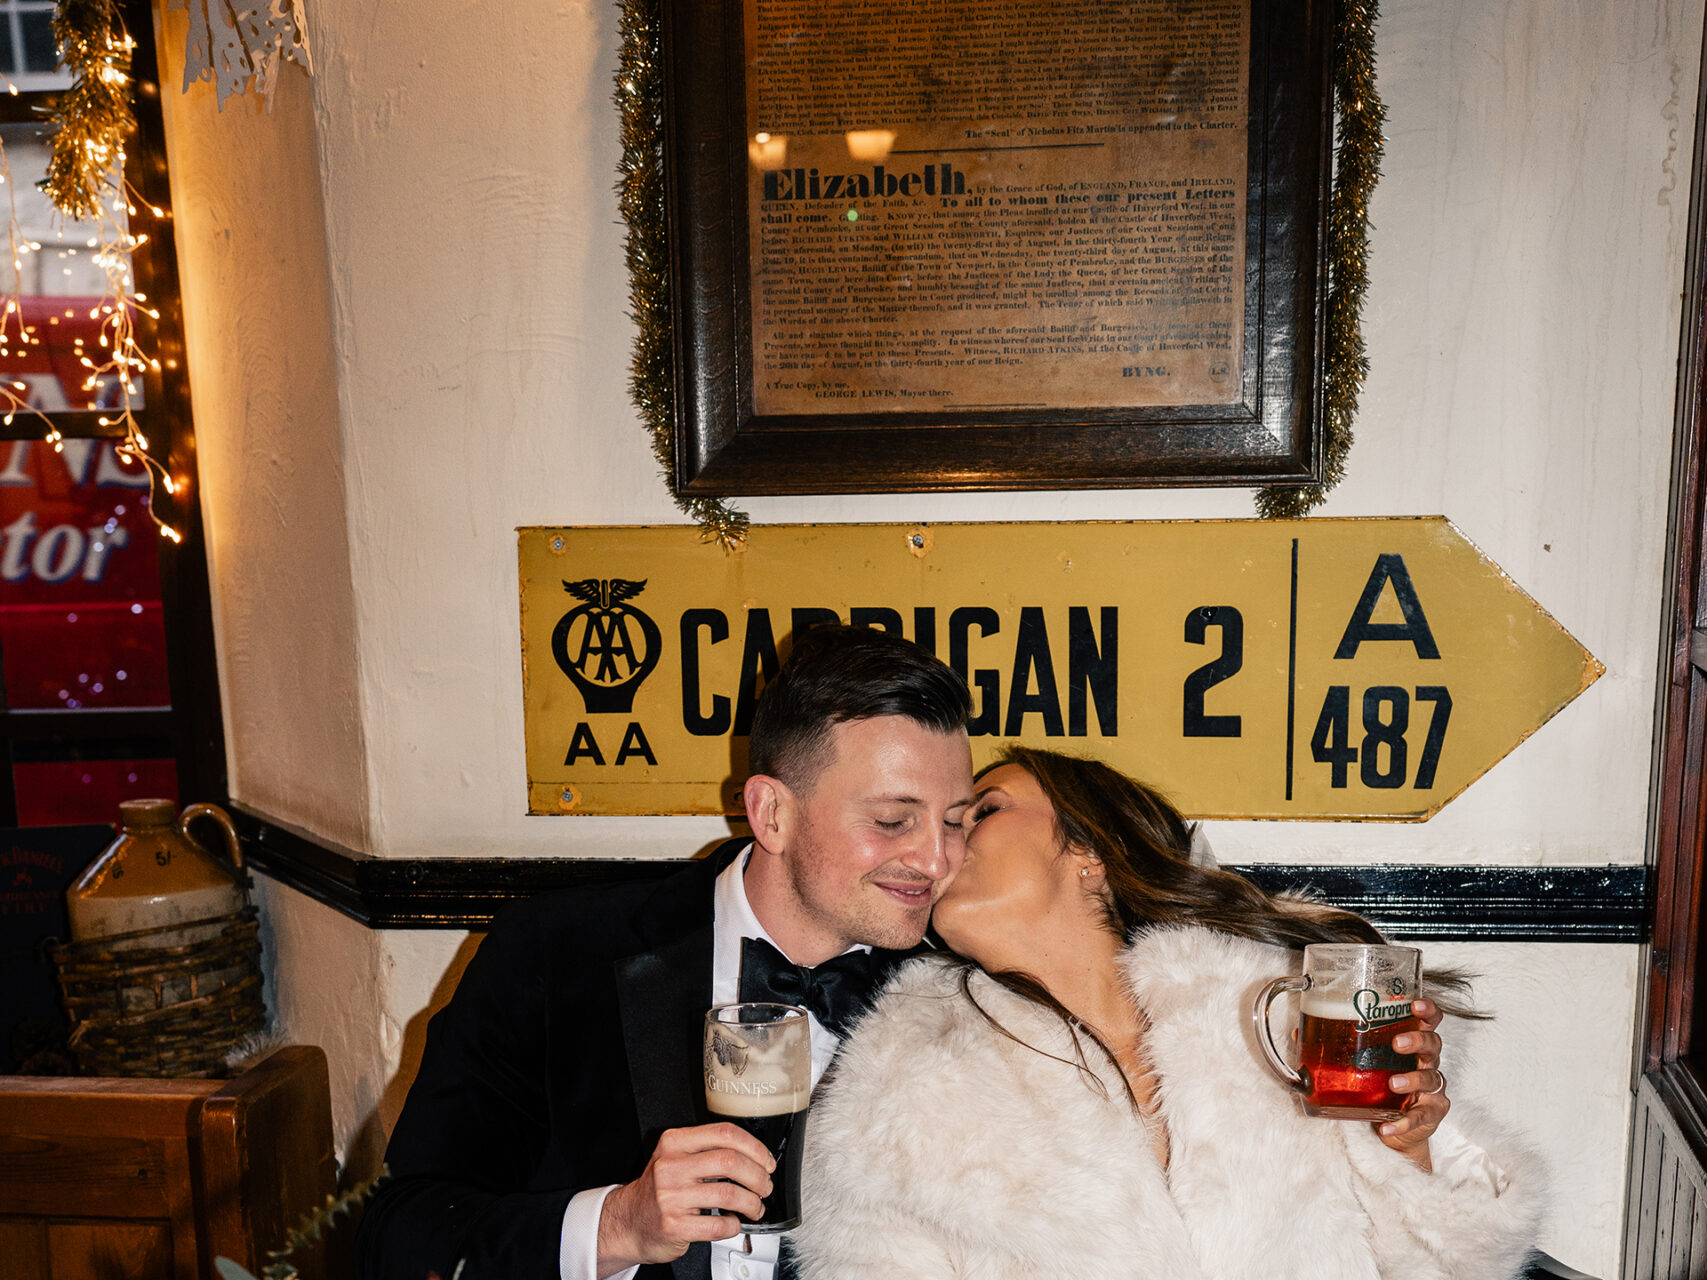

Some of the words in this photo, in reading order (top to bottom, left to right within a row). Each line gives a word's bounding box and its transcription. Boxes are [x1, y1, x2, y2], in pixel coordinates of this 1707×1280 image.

[763, 164, 973, 200] Elizabeth,
[939, 197, 958, 208] To
[965, 196, 982, 207] all
[988, 195, 1001, 206] to
[1008, 193, 1047, 205] whom
[1055, 192, 1090, 204] these
[1096, 193, 1120, 202] our
[1127, 189, 1176, 203] present
[1185, 186, 1235, 199] Letters
[760, 212, 792, 224] shall
[796, 214, 832, 223] come.
[838, 212, 878, 223] Grting.
[1333, 553, 1441, 660] A
[680, 606, 1118, 737] CAGAN
[1183, 605, 1243, 737] 2
[564, 721, 658, 767] AA
[1310, 685, 1453, 790] 487
[708, 1074, 777, 1095] GUINNESS
